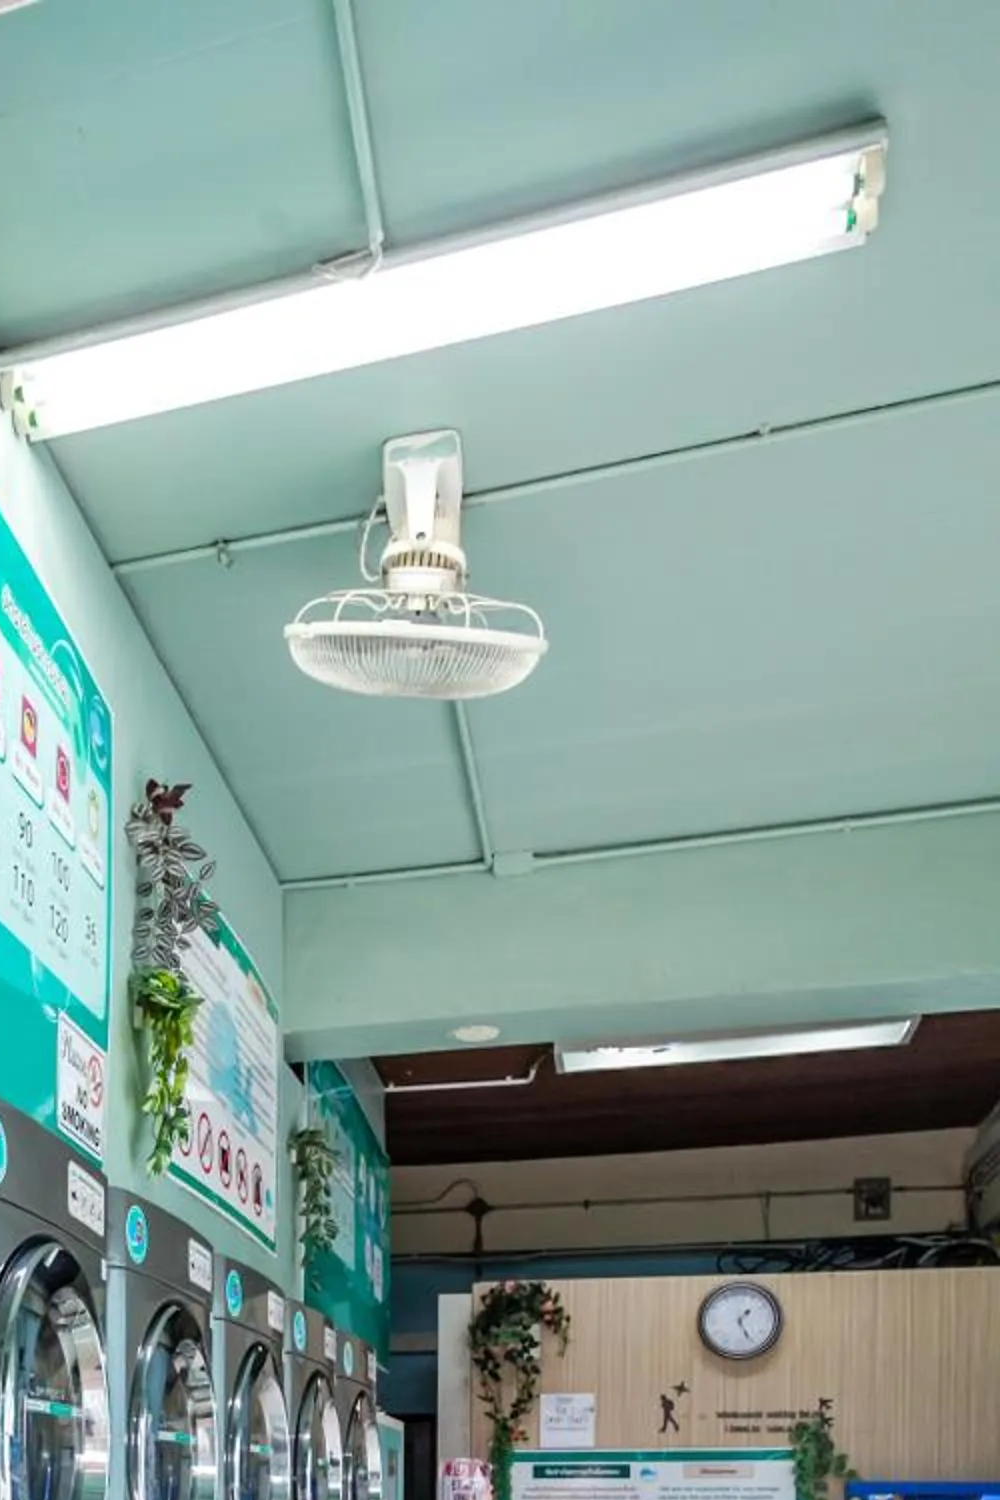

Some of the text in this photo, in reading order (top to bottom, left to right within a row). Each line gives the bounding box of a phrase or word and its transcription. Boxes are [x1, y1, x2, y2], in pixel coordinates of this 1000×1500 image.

[19, 812, 33, 848] 90
[13, 865, 34, 908] 110
[50, 905, 69, 943] 120
[62, 1100, 99, 1147] SMOKING
